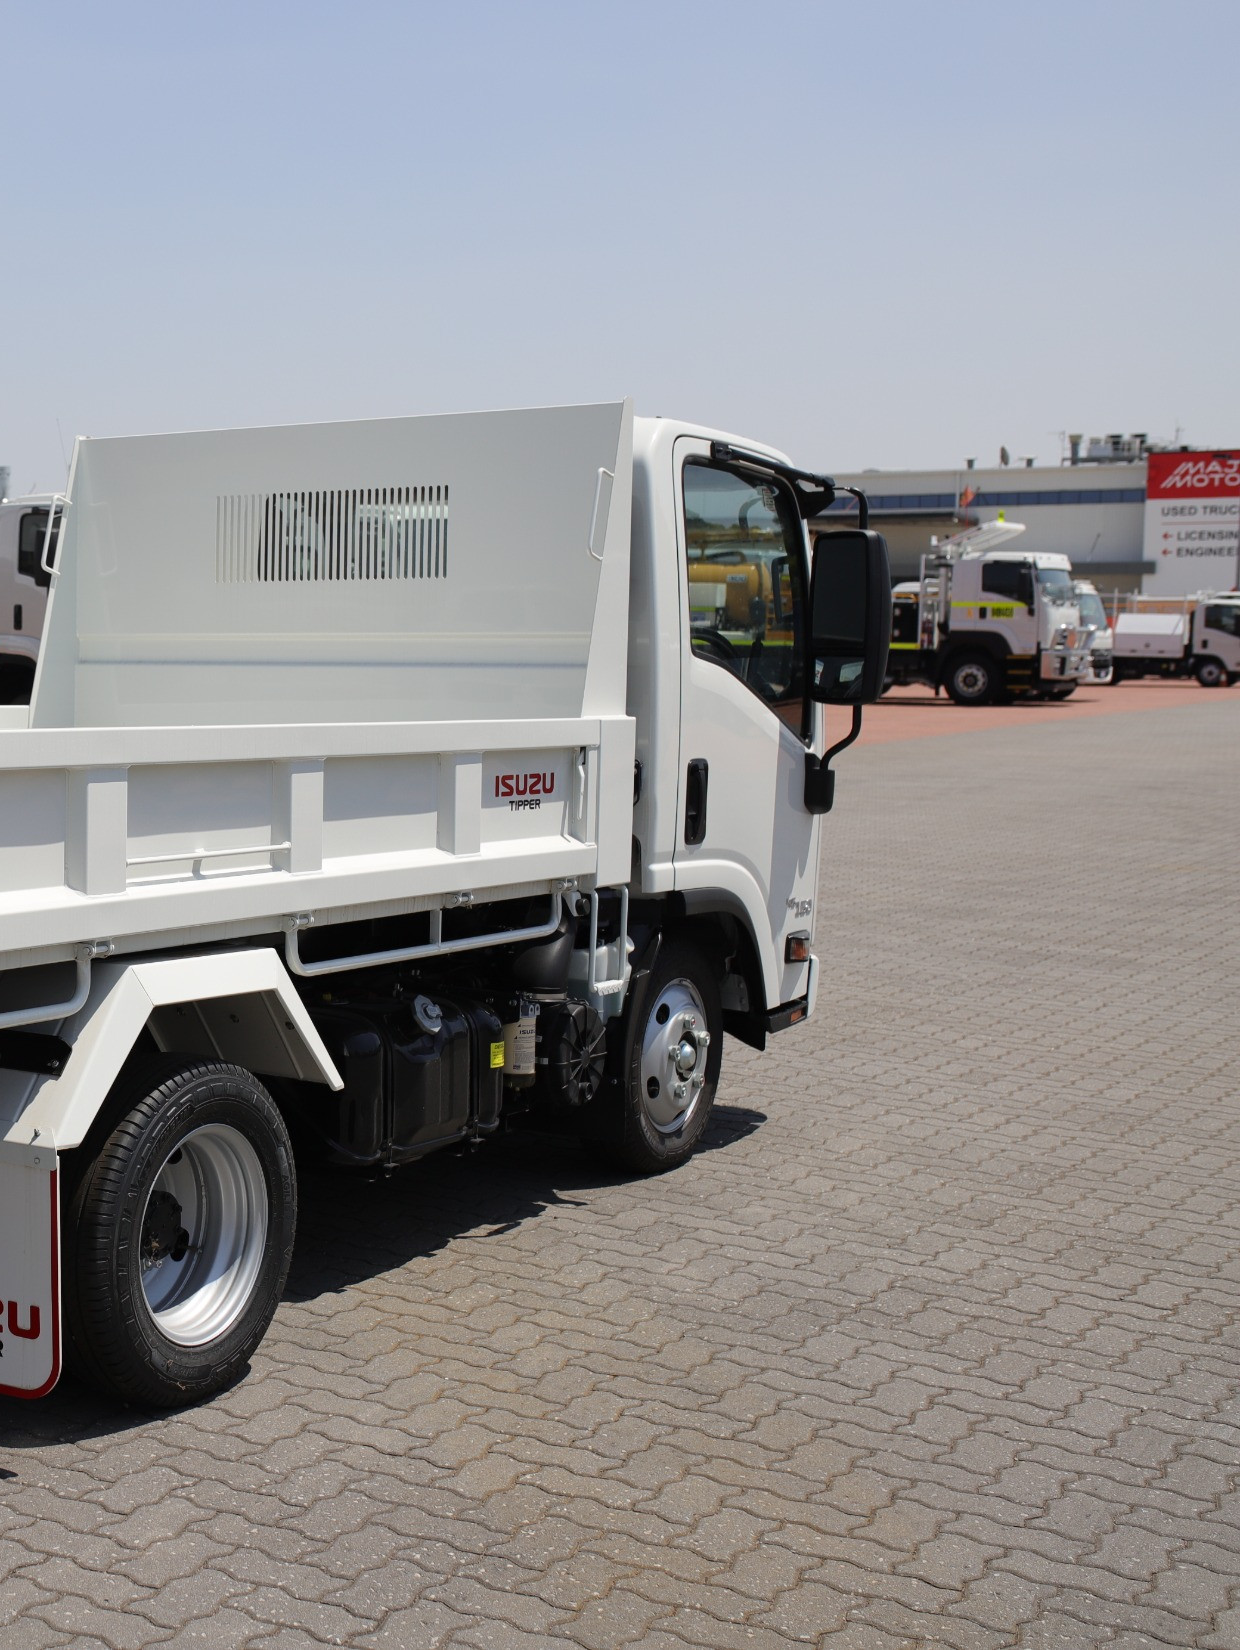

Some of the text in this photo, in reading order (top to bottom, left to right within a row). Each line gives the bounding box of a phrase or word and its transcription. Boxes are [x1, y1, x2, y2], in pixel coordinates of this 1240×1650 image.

[1161, 505, 1198, 516] USED
[494, 772, 555, 798] ISUZU
[508, 798, 541, 811] TIPPER
